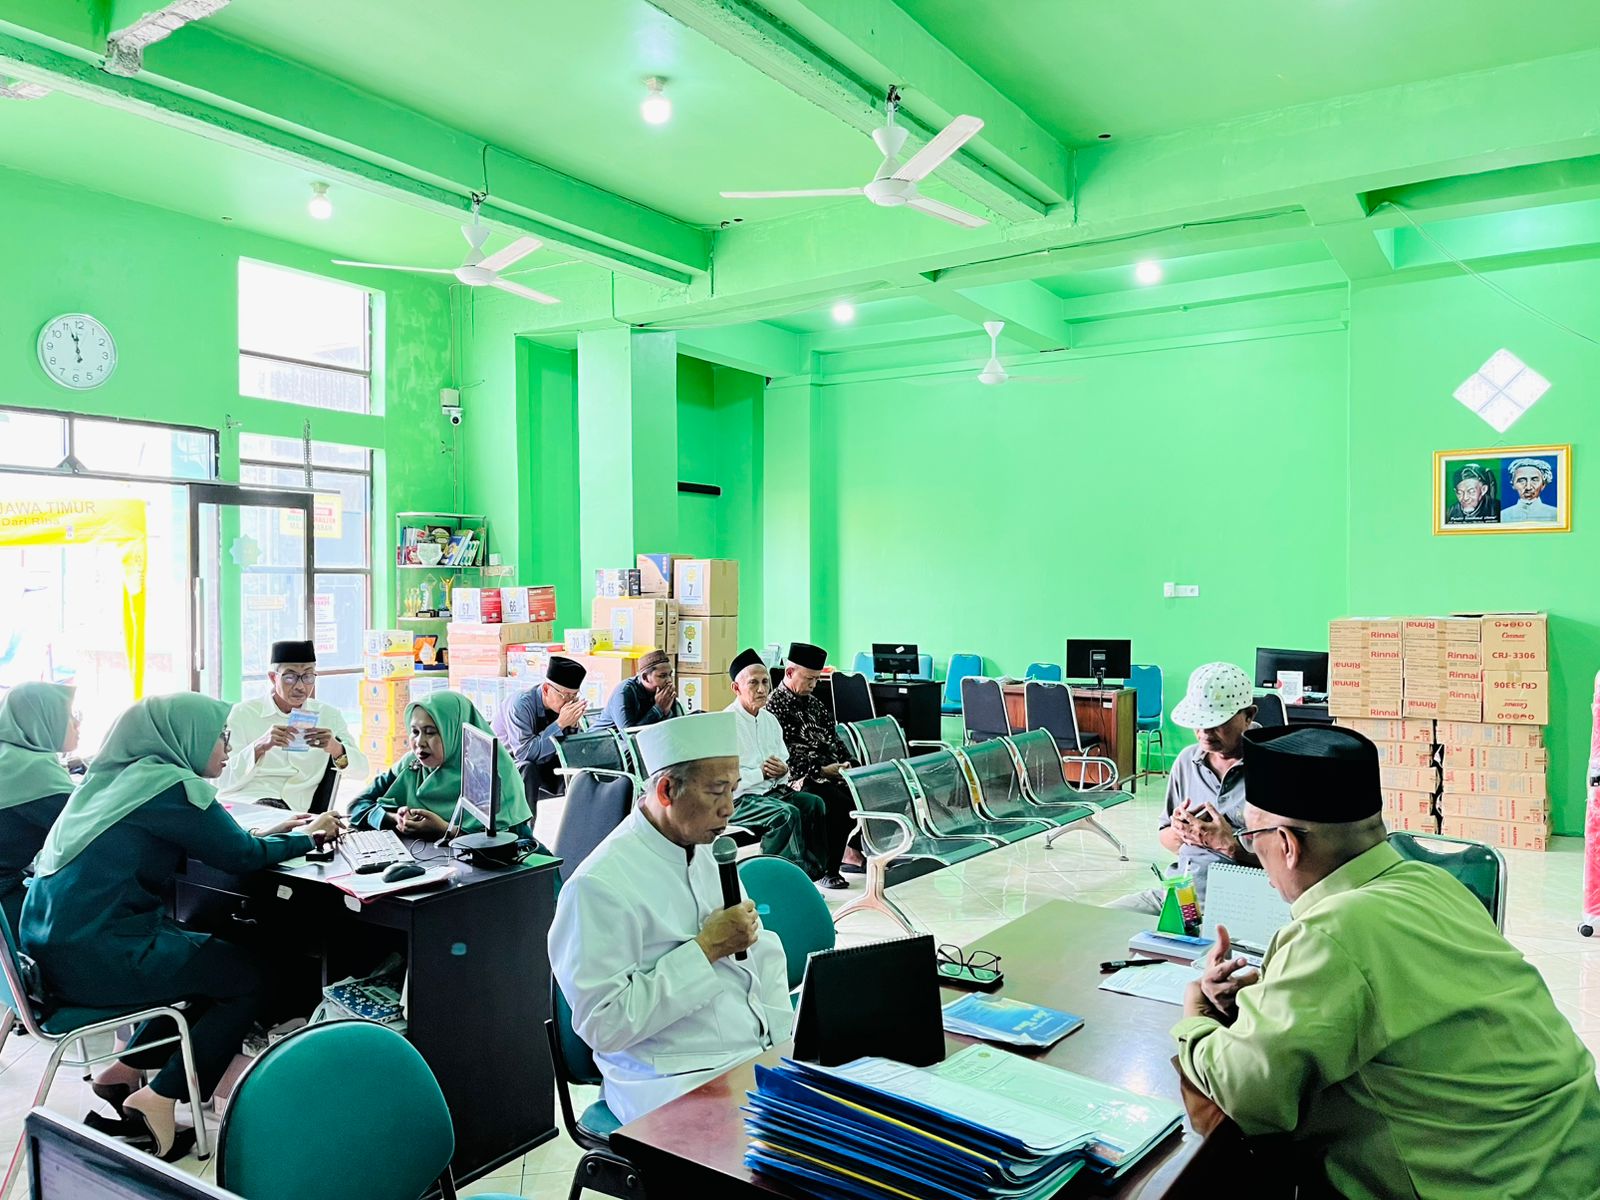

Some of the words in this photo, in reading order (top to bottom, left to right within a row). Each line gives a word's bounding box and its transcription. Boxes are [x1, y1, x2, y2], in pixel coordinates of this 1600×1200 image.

[63, 322, 68, 330] 11
[75, 321, 84, 330] 12
[52, 330, 62, 338] 10
[46, 342, 54, 350] 9
[98, 338, 106, 346] 2
[102, 352, 108, 360] 3
[50, 356, 56, 366] 8
[60, 368, 66, 376] 7
[86, 372, 93, 380] 5
[72, 374, 80, 382] 6
[46, 501, 96, 514] TIMUR
[2, 517, 27, 526] Dari
[688, 584, 694, 596] 7
[619, 628, 624, 640] 2
[687, 641, 692, 653] 6
[1448, 671, 1478, 679] Rinnai
[1449, 690, 1480, 699] Rinnai
[687, 698, 692, 710] 5
[1408, 700, 1436, 709] Rinnai
